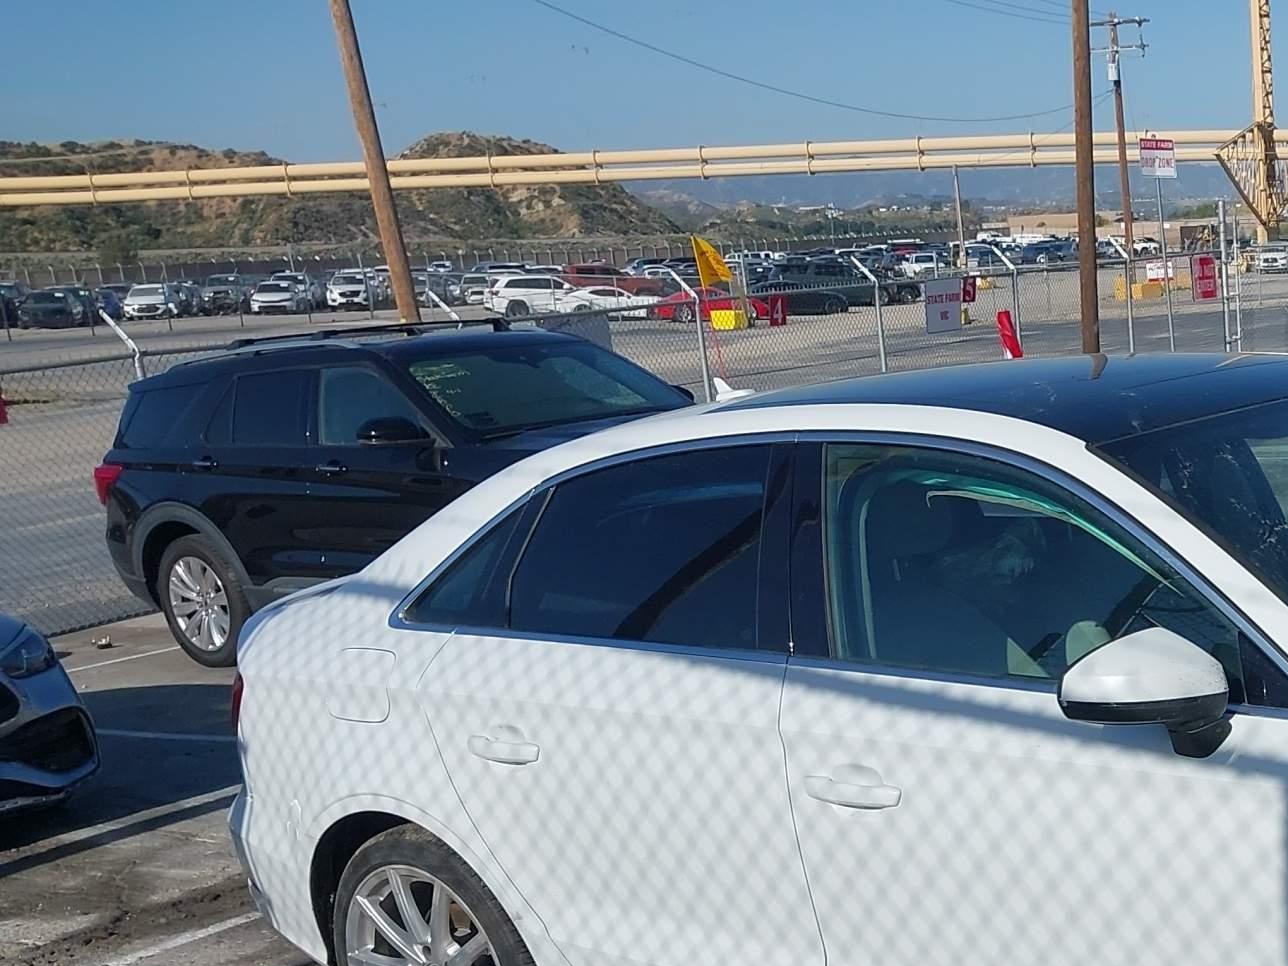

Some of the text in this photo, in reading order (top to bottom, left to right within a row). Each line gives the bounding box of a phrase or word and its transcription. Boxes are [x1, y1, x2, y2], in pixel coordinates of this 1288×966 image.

[1141, 140, 1173, 149] STATE FARM
[1140, 157, 1174, 169] DROP ZONE
[772, 297, 784, 323] 4
